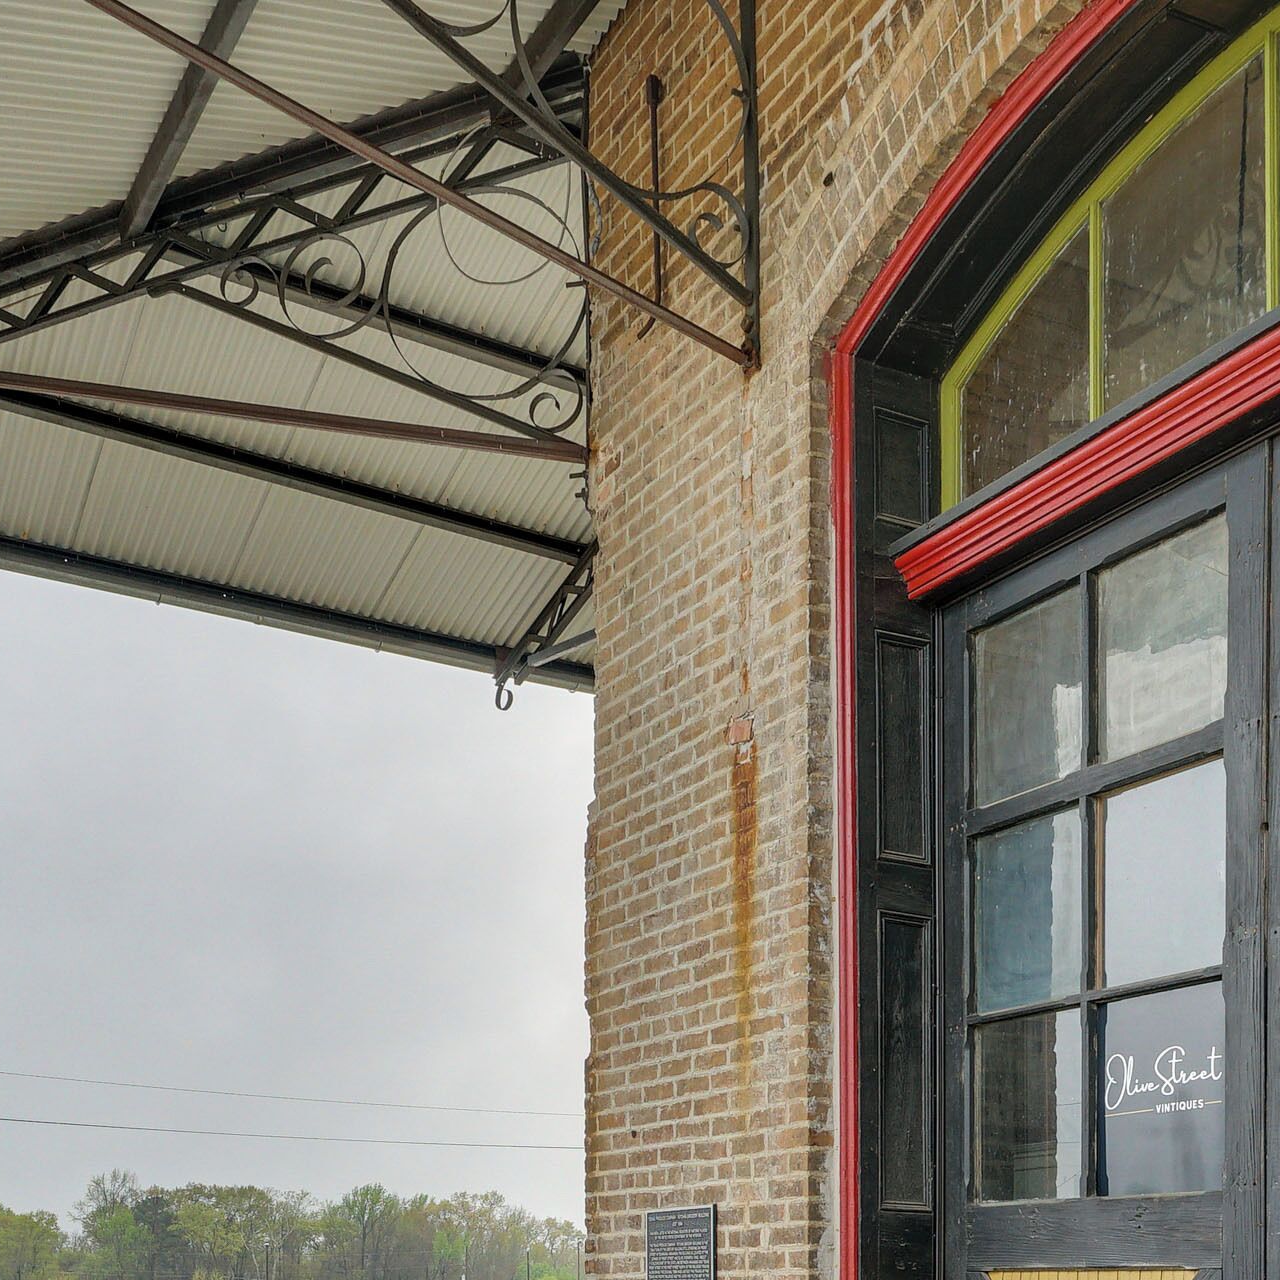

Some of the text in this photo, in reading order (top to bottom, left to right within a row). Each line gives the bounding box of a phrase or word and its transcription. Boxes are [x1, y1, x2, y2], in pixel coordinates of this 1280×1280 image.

[1105, 1045, 1222, 1110] Olive Street
[1156, 1098, 1204, 1114] VINTIQUES
